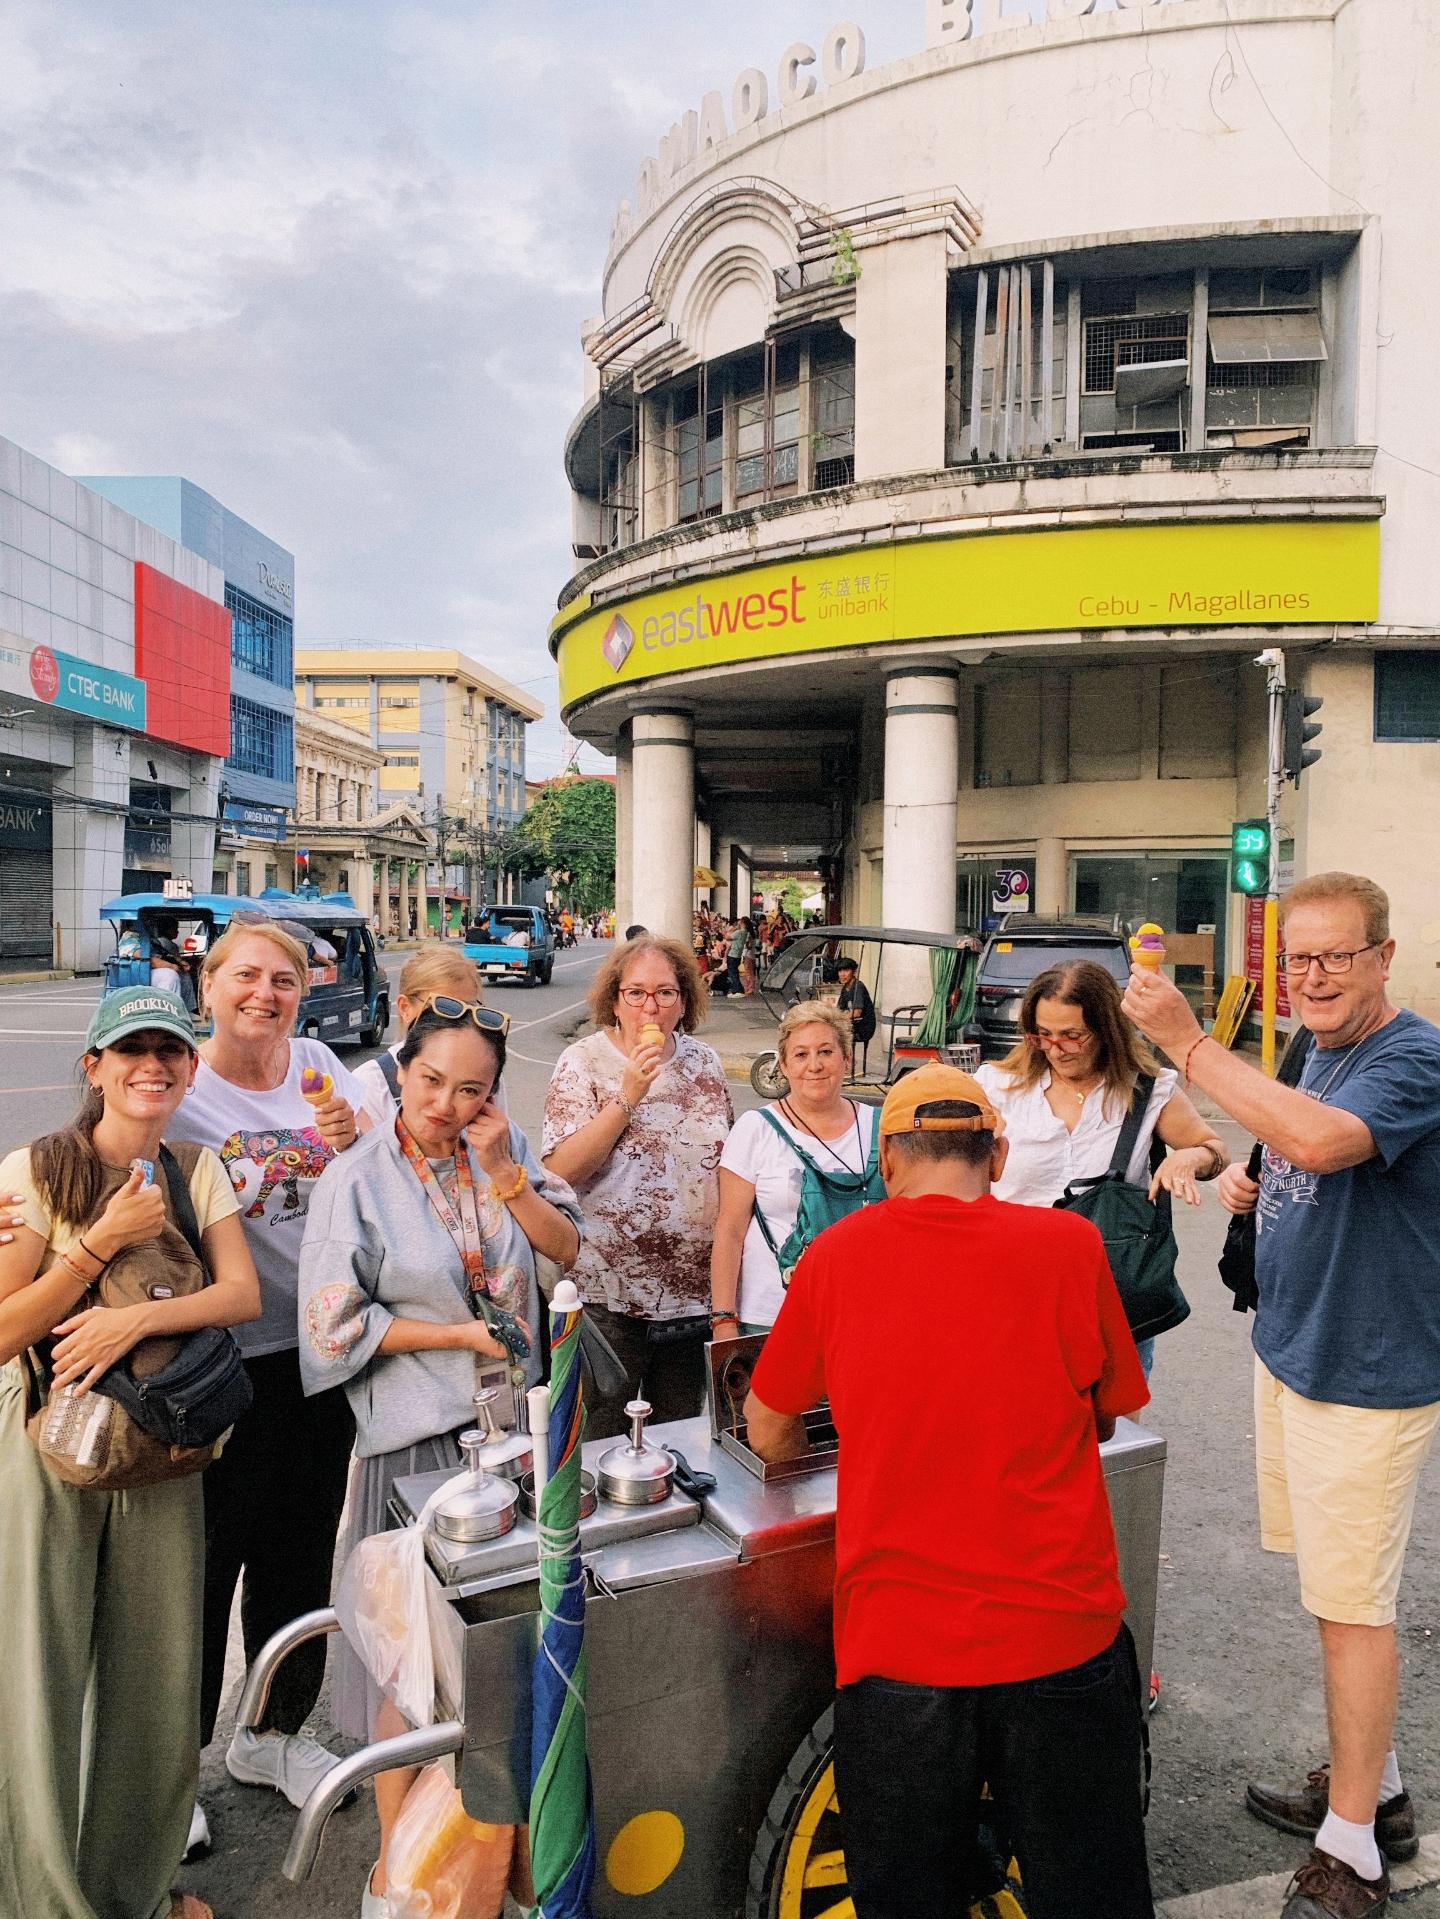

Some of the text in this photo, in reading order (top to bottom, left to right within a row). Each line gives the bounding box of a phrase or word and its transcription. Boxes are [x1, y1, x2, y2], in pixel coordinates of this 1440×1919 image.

[818, 571, 890, 598] 东盛银行
[642, 576, 807, 651] eastwest
[818, 594, 889, 620] unibank
[1079, 596, 1139, 617] Cebu
[1168, 590, 1310, 616] Magallanes
[67, 673, 136, 712] CTBC BANK
[119, 998, 180, 1019] BROOKLYN
[1278, 1173, 1307, 1191] NORTH
